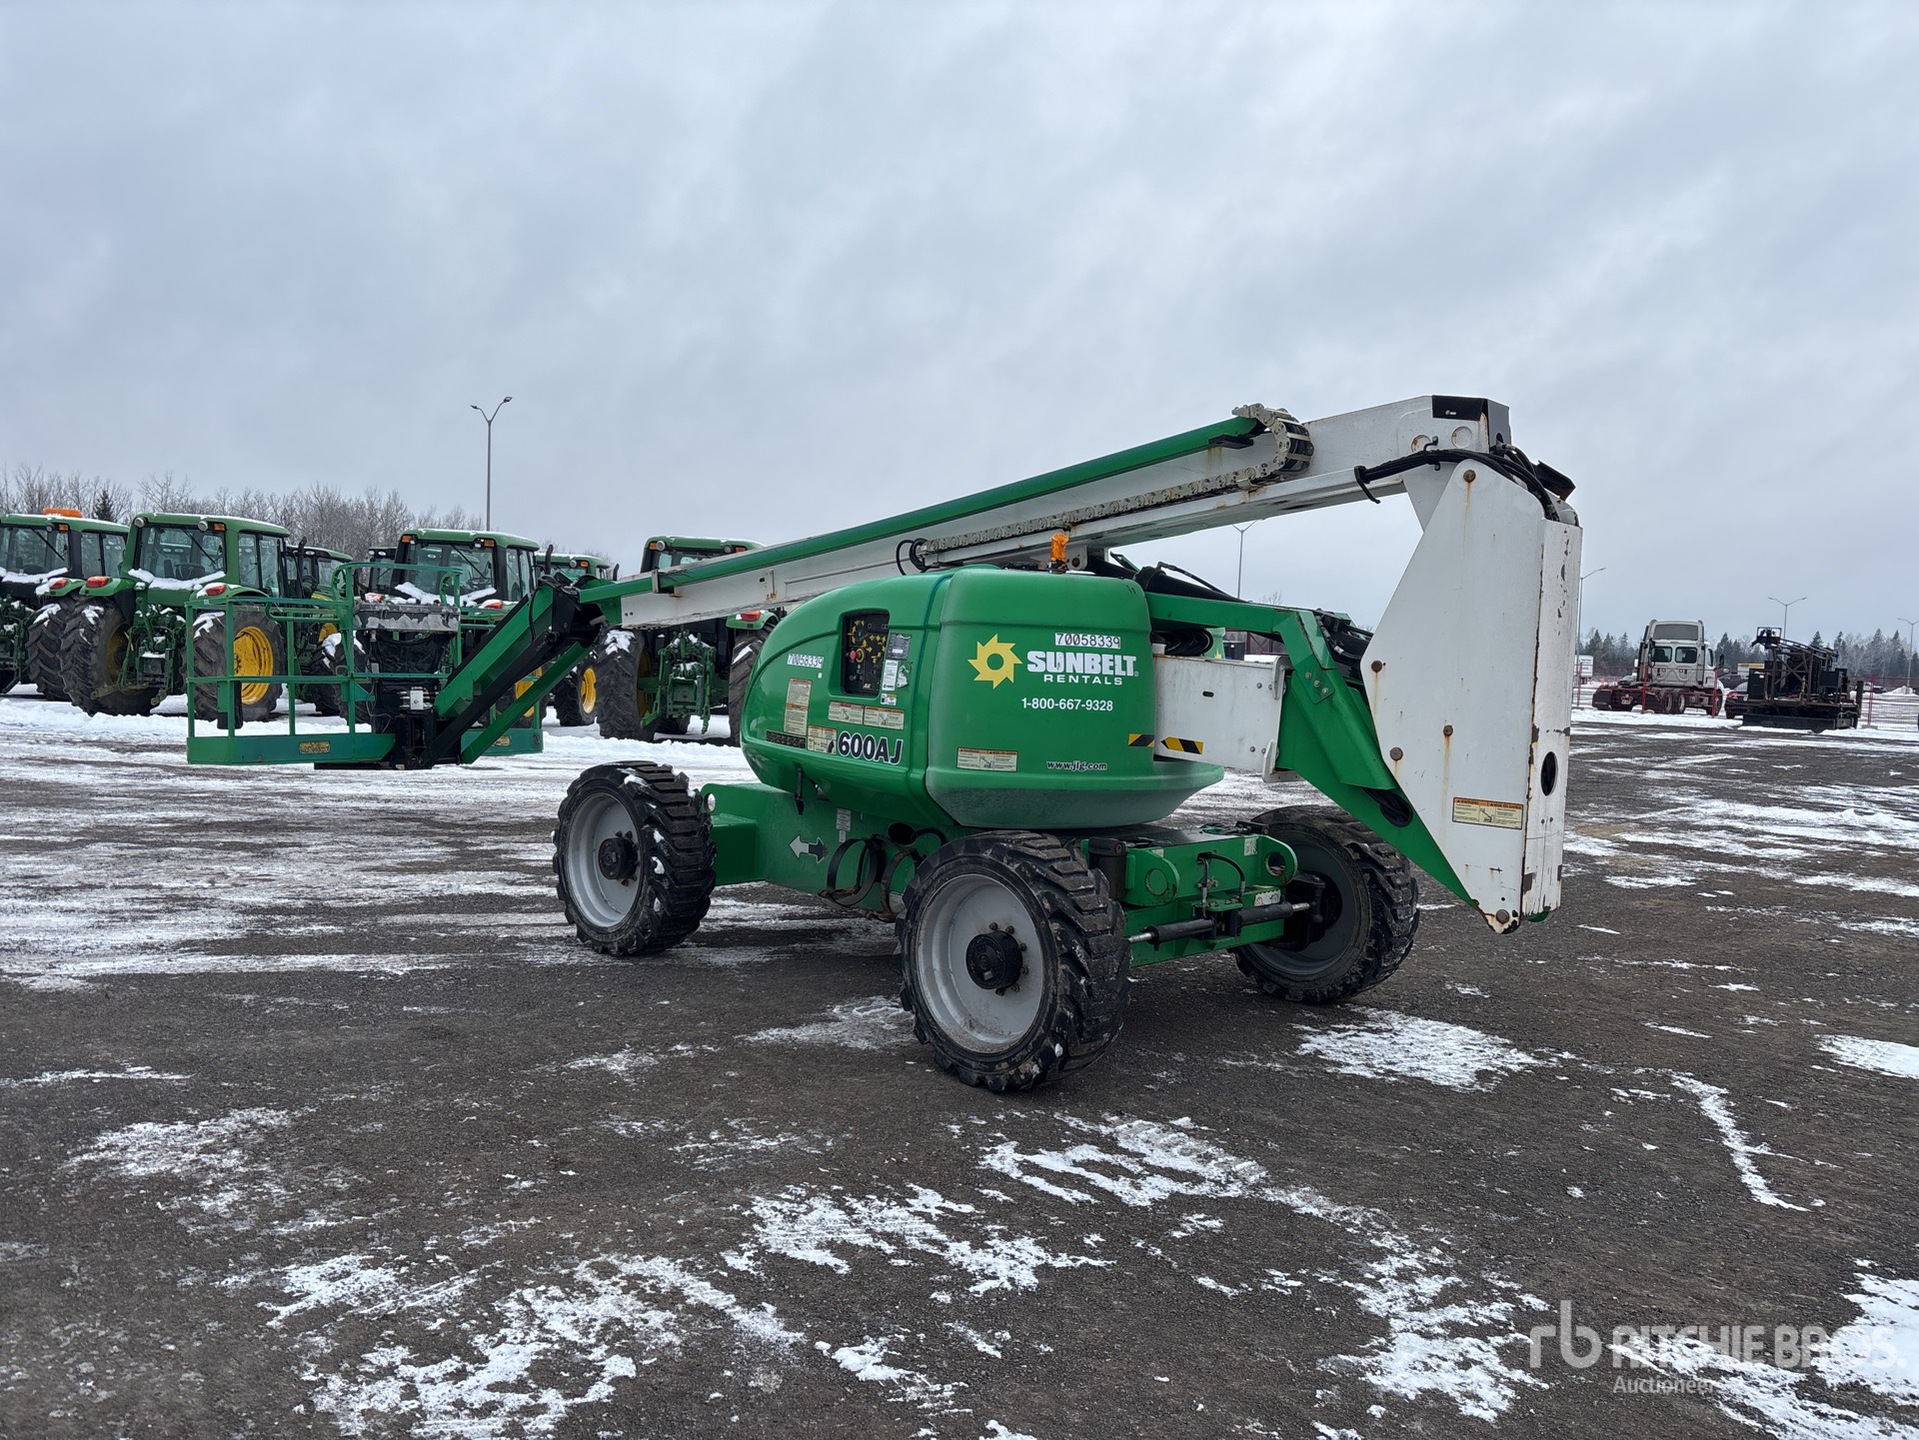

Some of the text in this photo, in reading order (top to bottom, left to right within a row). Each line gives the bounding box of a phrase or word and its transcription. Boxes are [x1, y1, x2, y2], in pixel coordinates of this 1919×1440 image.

[1057, 633, 1121, 649] 70058339
[1027, 650, 1137, 677] SUNBELT
[1044, 674, 1123, 686] RENTALS
[1021, 697, 1114, 712] 1-800-667-9328
[838, 731, 904, 766] 600AJ
[1046, 760, 1108, 773] www.jlg.com
